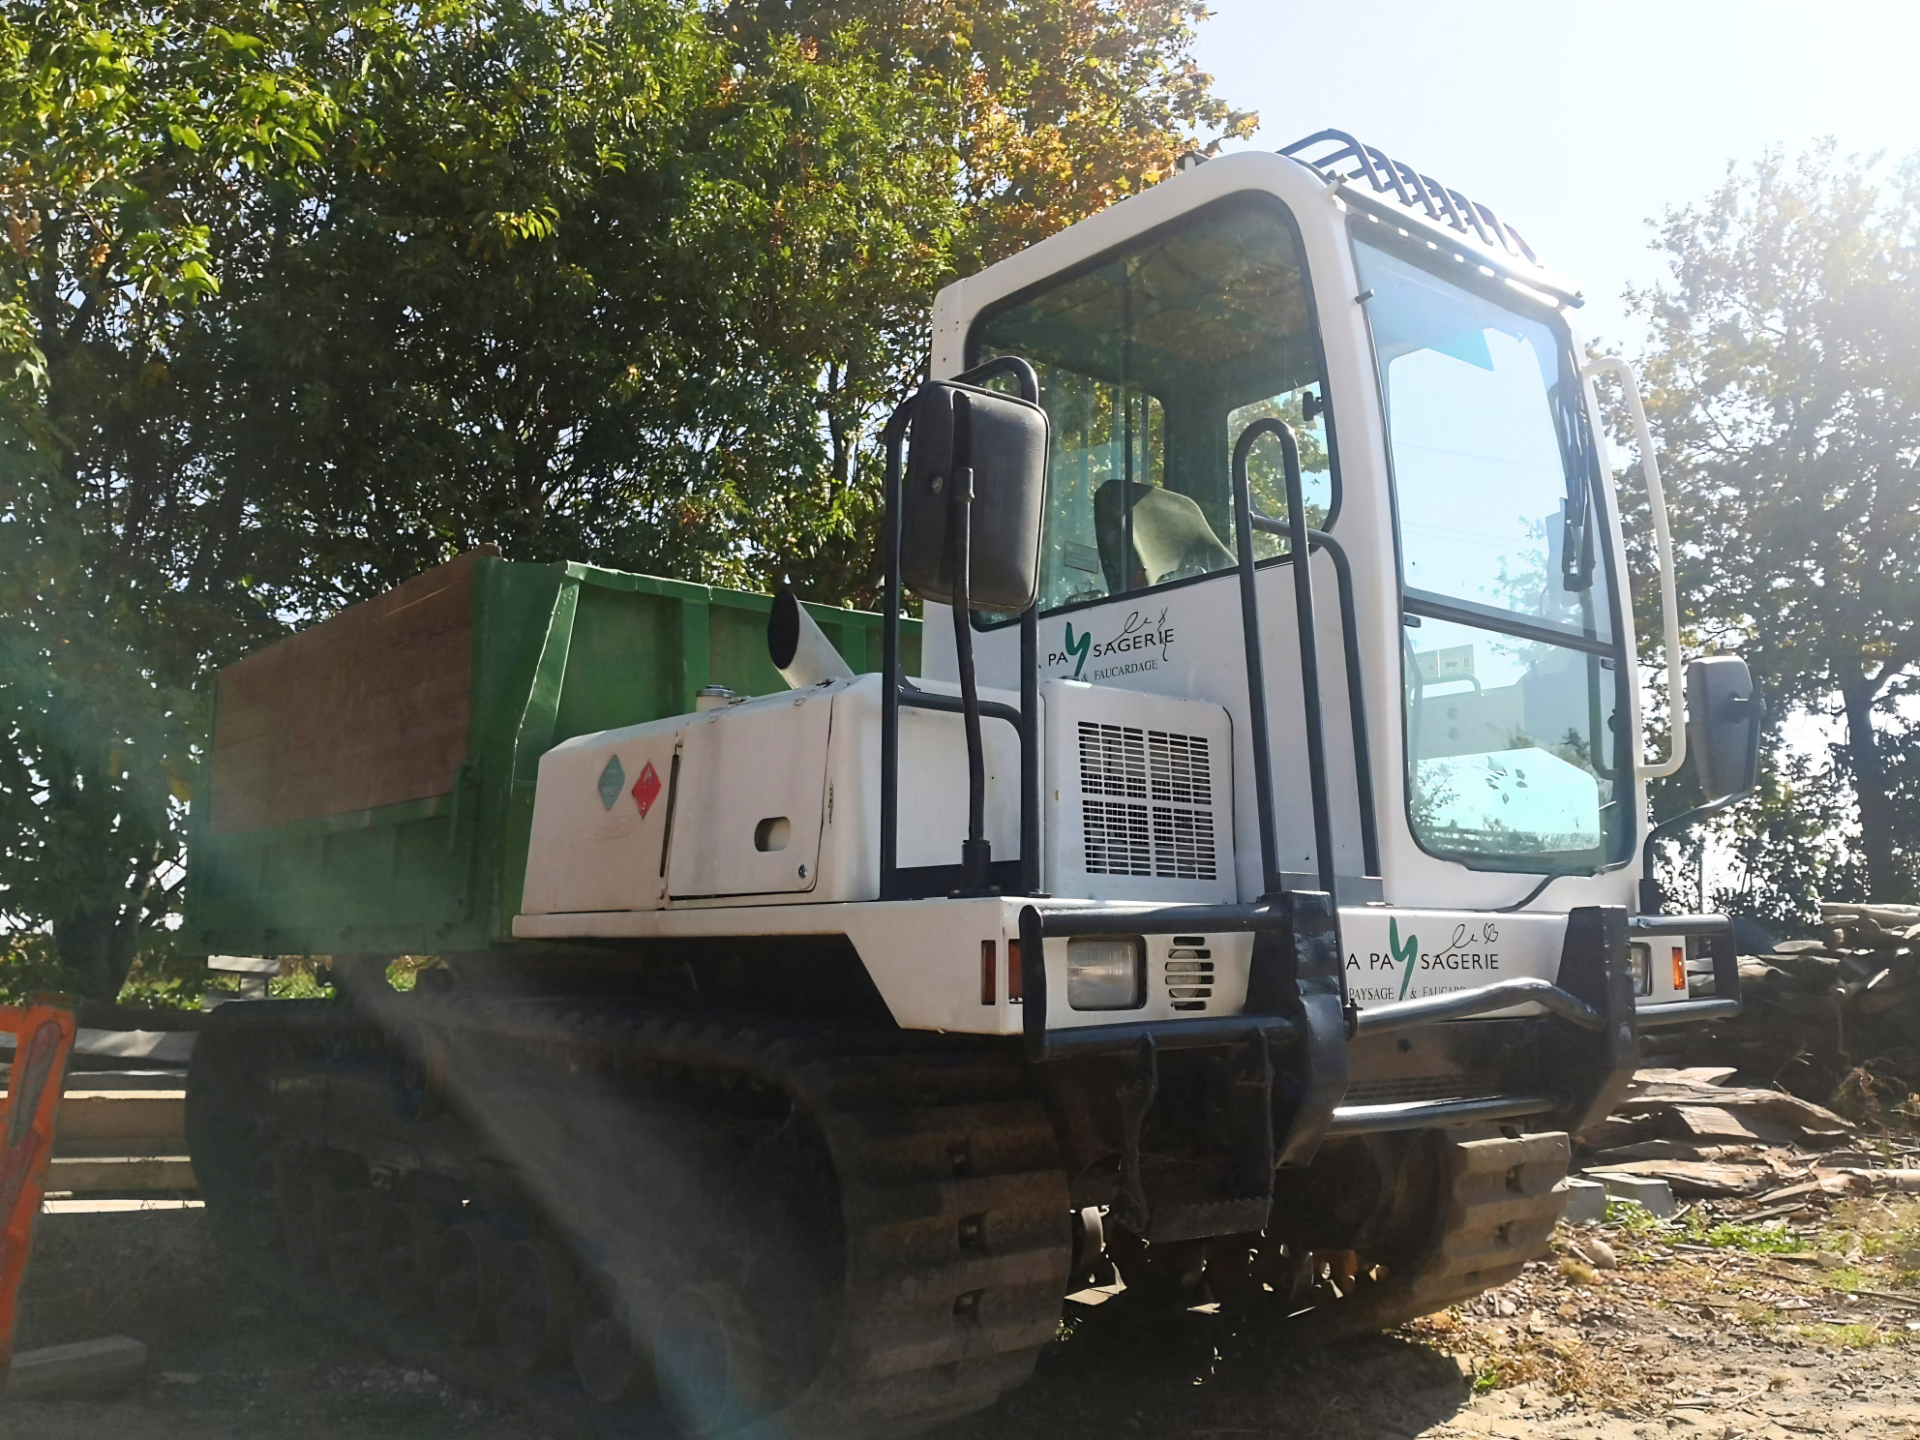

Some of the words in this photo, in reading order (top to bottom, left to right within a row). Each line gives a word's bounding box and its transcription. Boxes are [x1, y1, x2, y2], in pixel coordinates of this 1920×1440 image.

[1094, 659, 1158, 680] FAUCARDAGE
[1349, 987, 1395, 1000] PAYSAGE
[1409, 987, 1417, 999] &
